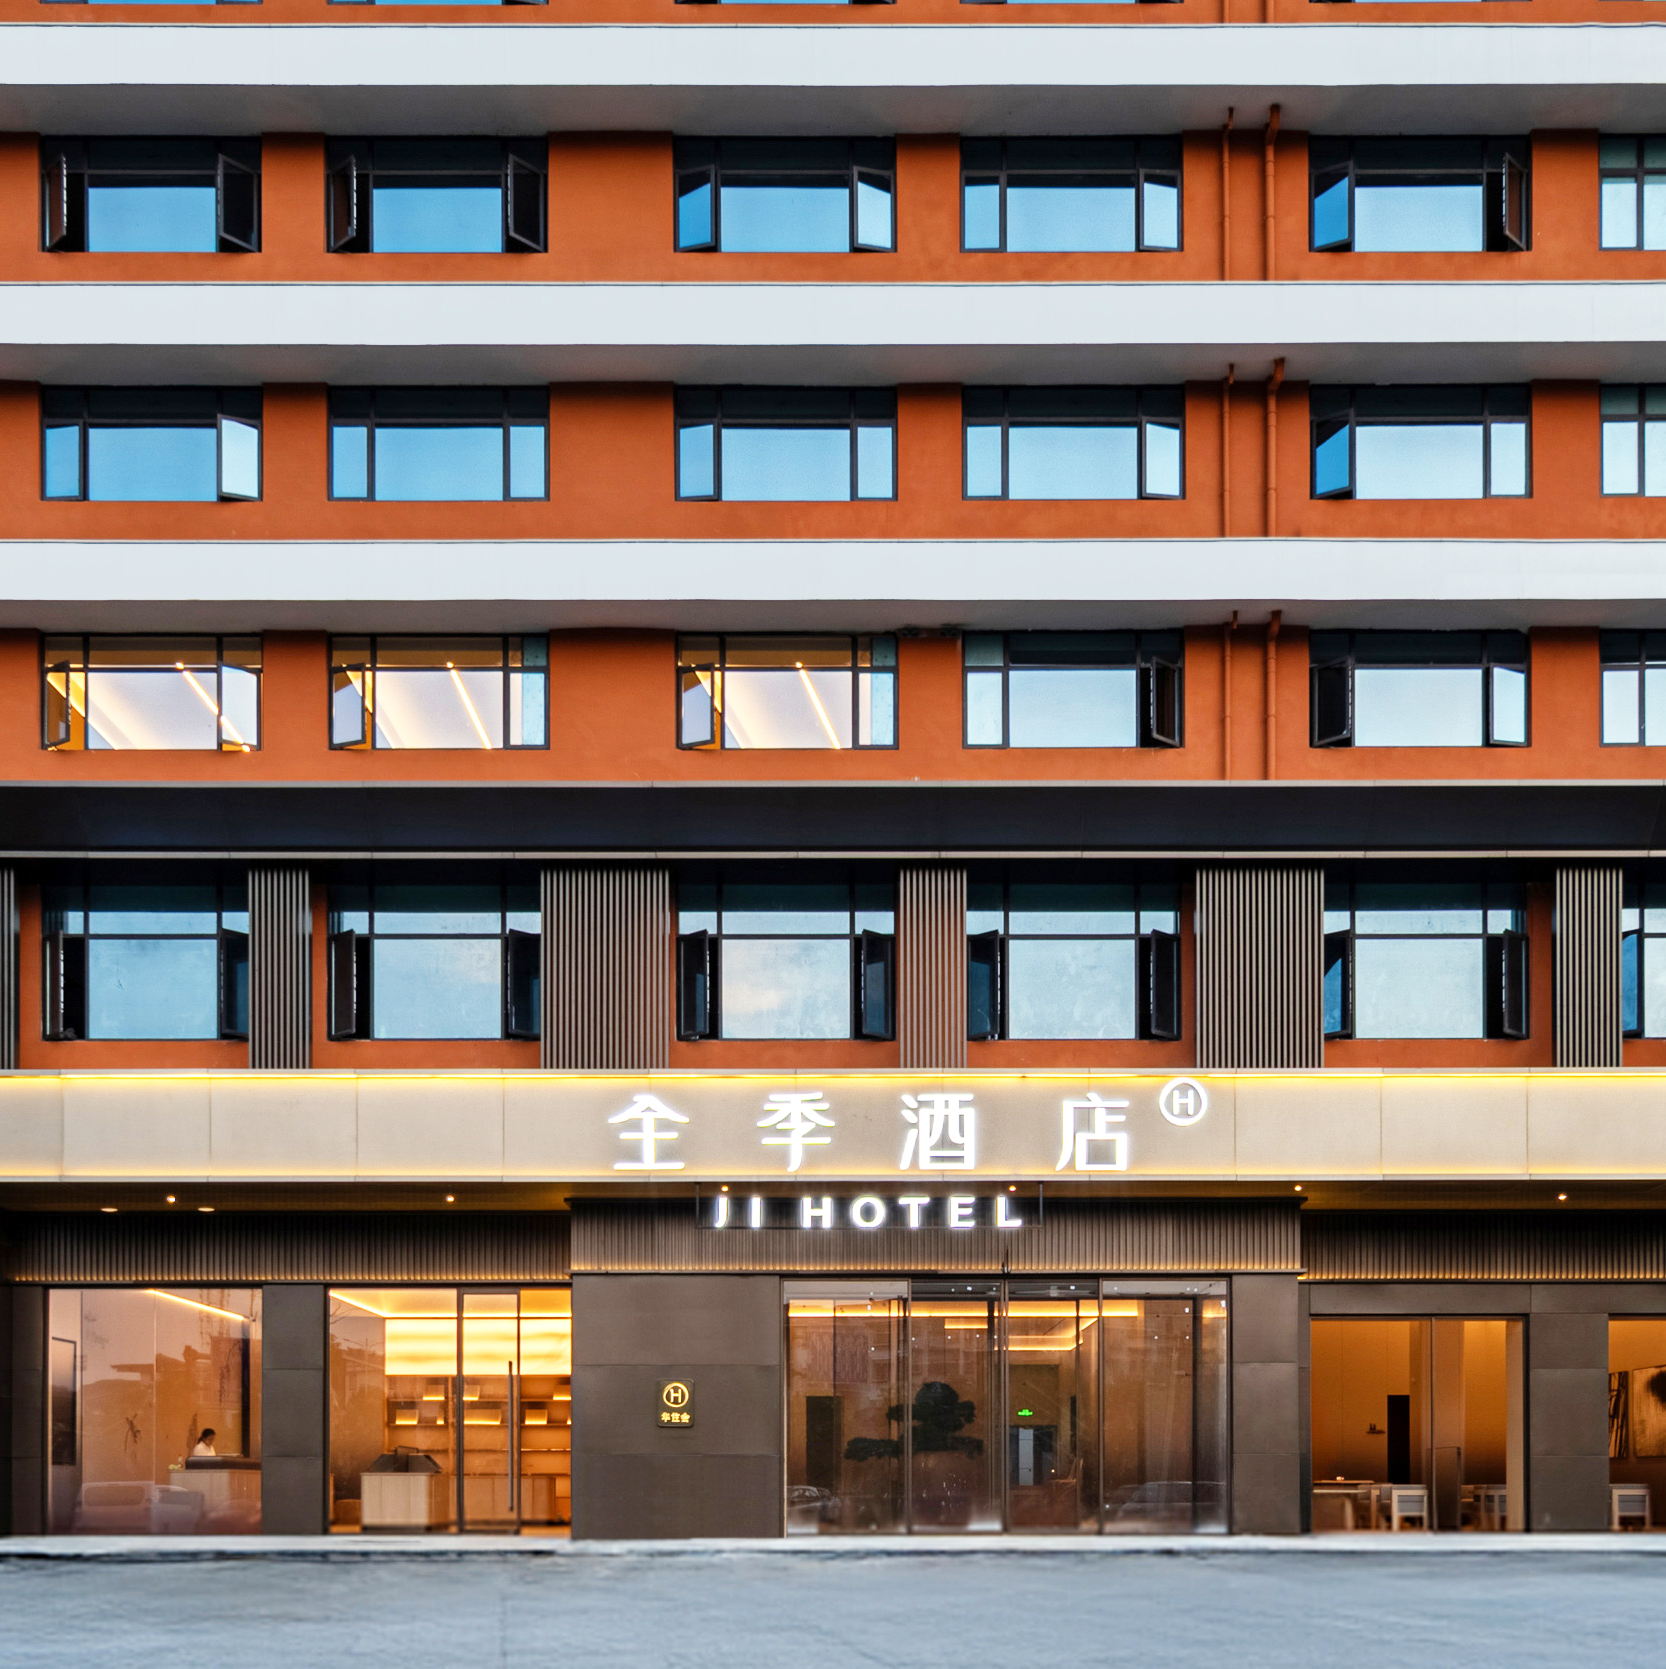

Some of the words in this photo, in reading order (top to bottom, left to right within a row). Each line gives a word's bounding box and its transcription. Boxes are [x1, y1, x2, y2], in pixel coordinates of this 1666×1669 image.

[607, 1090, 1131, 1173] 全季酒店
[714, 1195, 763, 1229] JI
[801, 1195, 1023, 1229] HOTEL
[660, 1411, 691, 1423] 华住会
